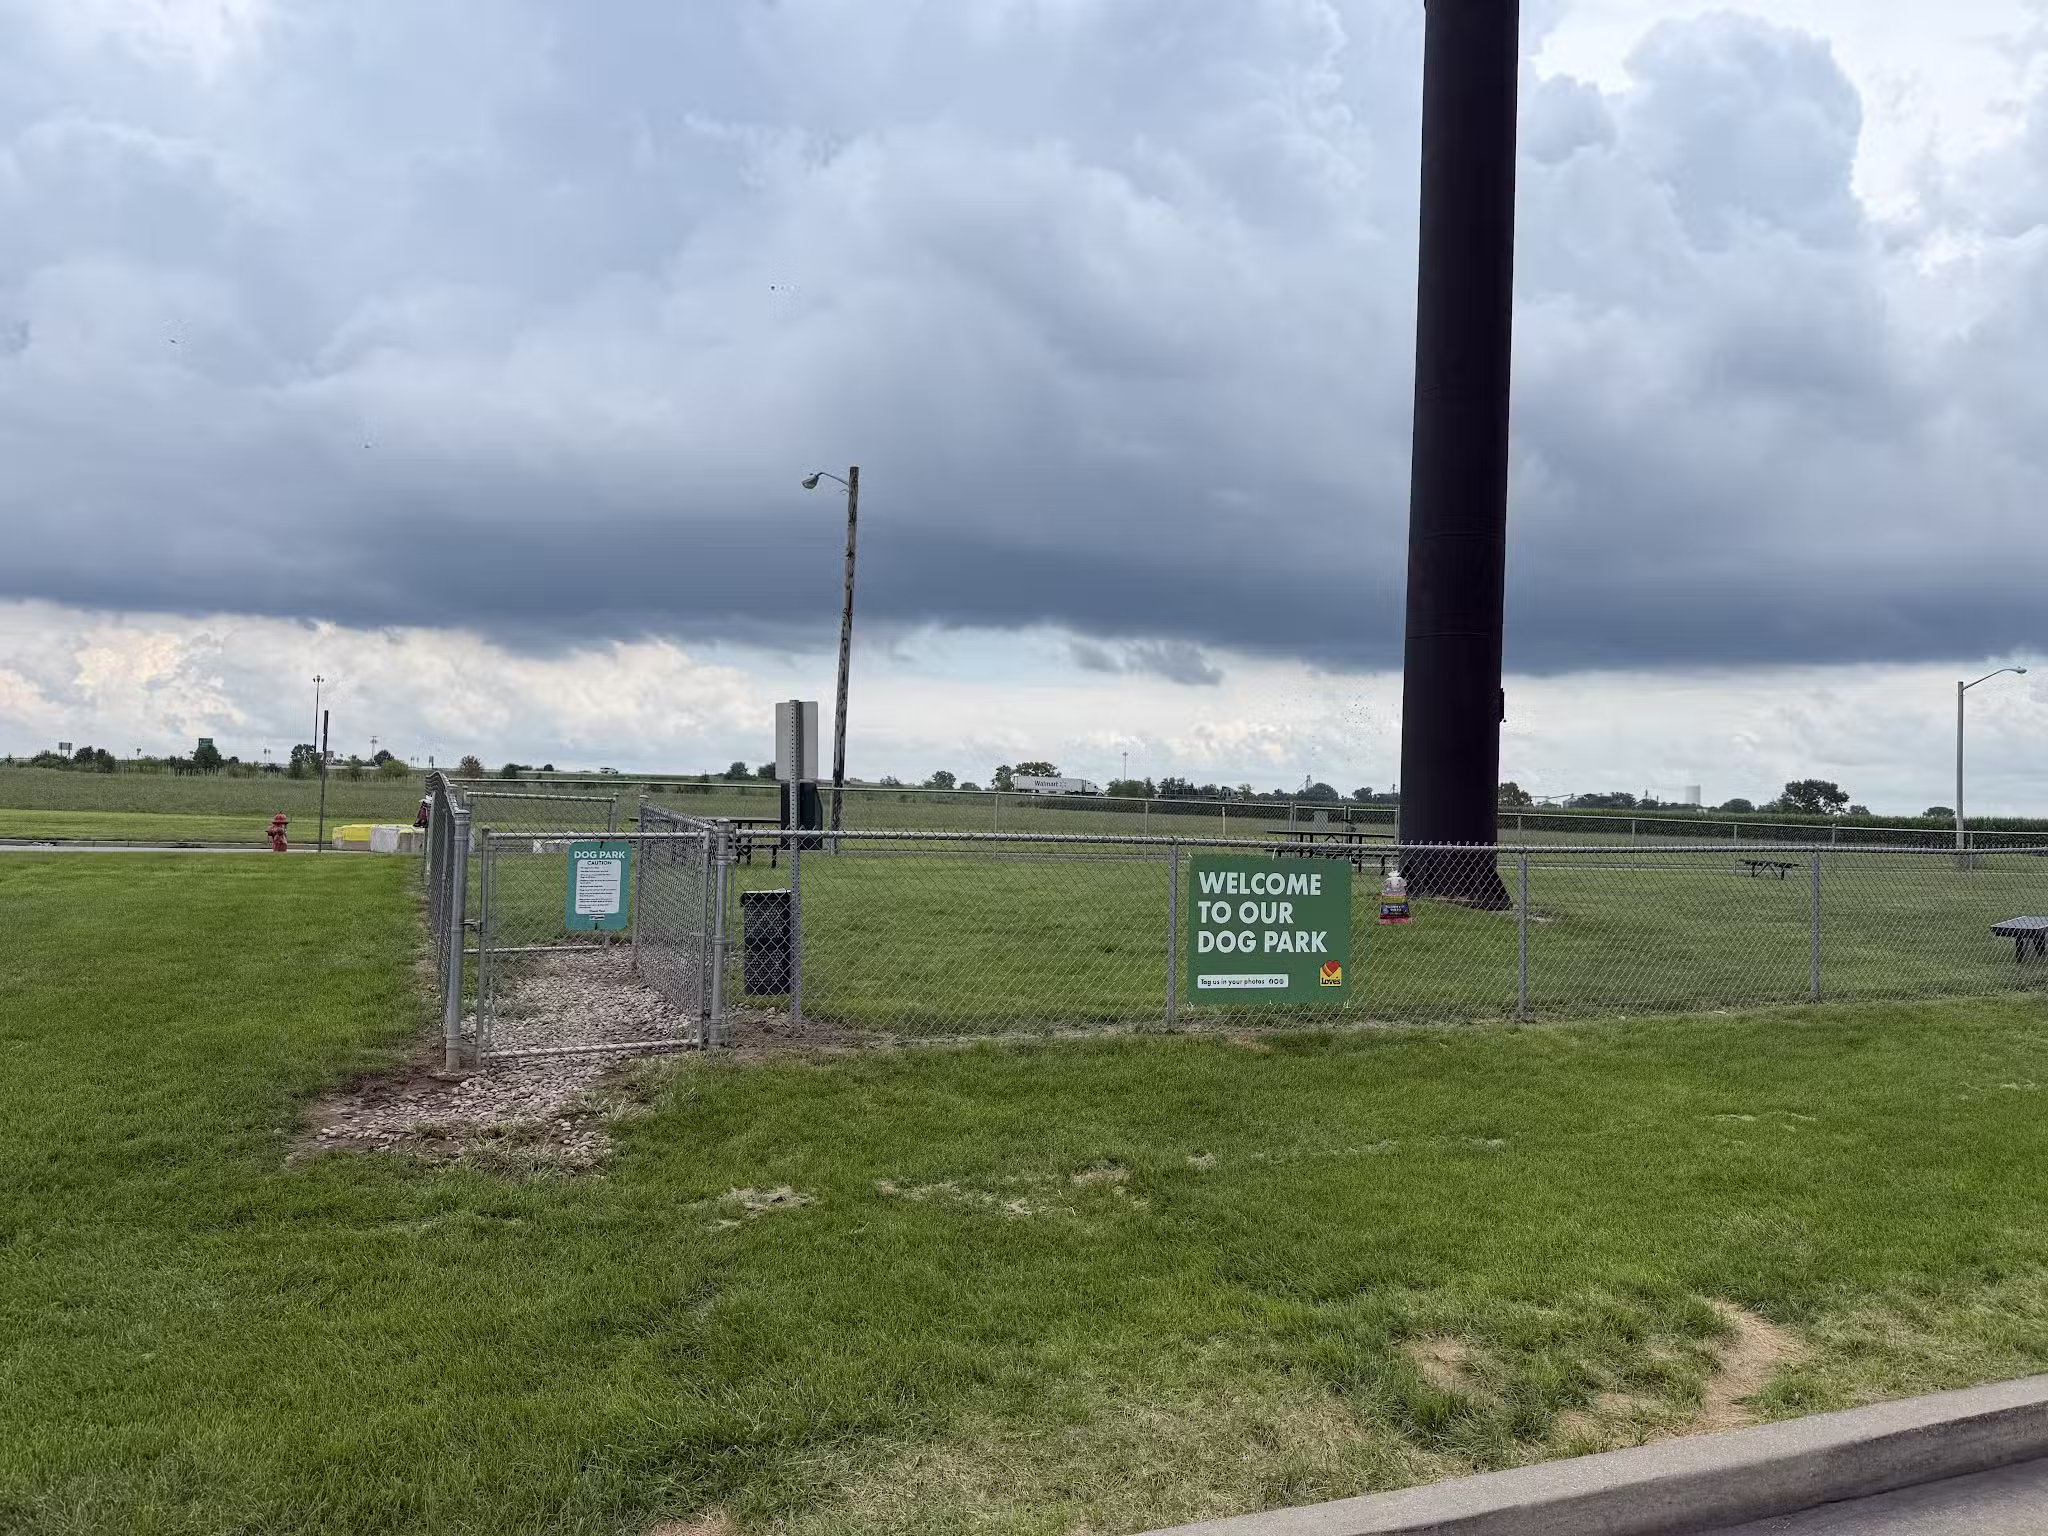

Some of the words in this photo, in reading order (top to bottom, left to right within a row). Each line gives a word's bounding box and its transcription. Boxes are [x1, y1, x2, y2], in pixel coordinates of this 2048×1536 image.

[574, 851, 597, 859] DOG
[599, 851, 625, 859] PARK
[1199, 872, 1321, 895] WELCOME
[1198, 901, 1232, 924] TO
[1239, 901, 1294, 924] OUR
[1198, 930, 1257, 953] DOG
[1264, 930, 1328, 953] PARK
[1201, 979, 1212, 987] Tag
[1243, 978, 1265, 987] photos
